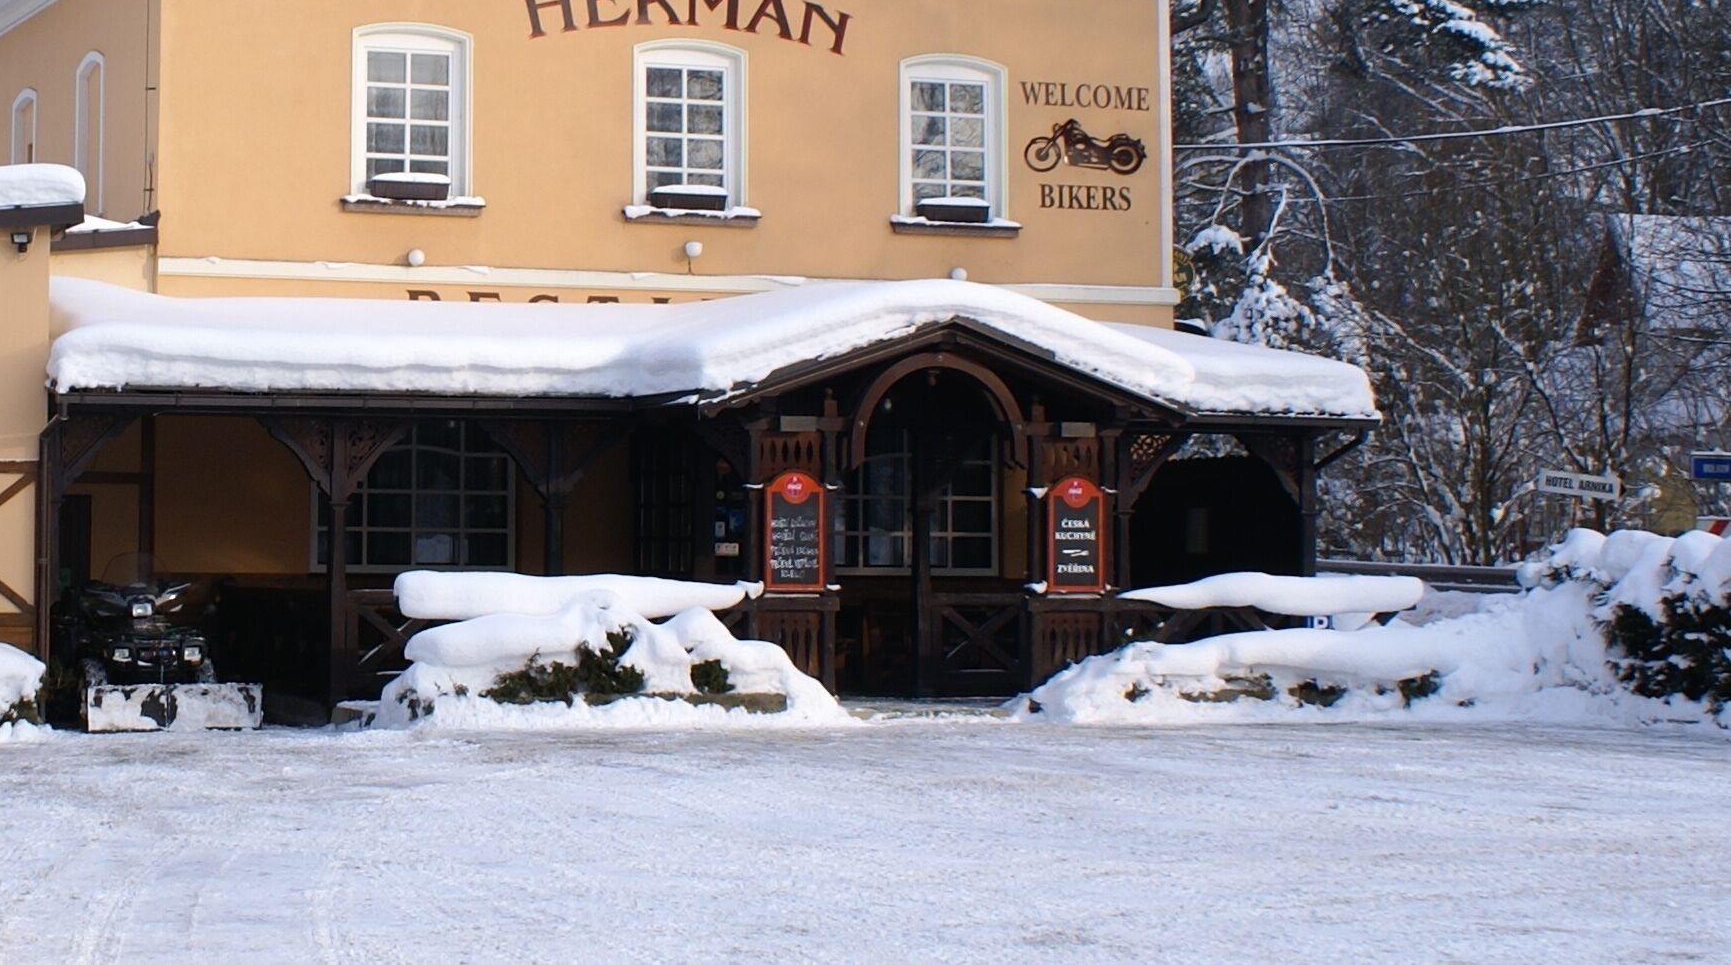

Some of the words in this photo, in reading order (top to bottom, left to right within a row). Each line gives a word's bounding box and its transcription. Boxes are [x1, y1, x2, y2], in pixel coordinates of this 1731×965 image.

[1020, 81, 1150, 111] WELCOME
[1039, 183, 1132, 211] BIKERS
[1545, 475, 1574, 489] HOTEL
